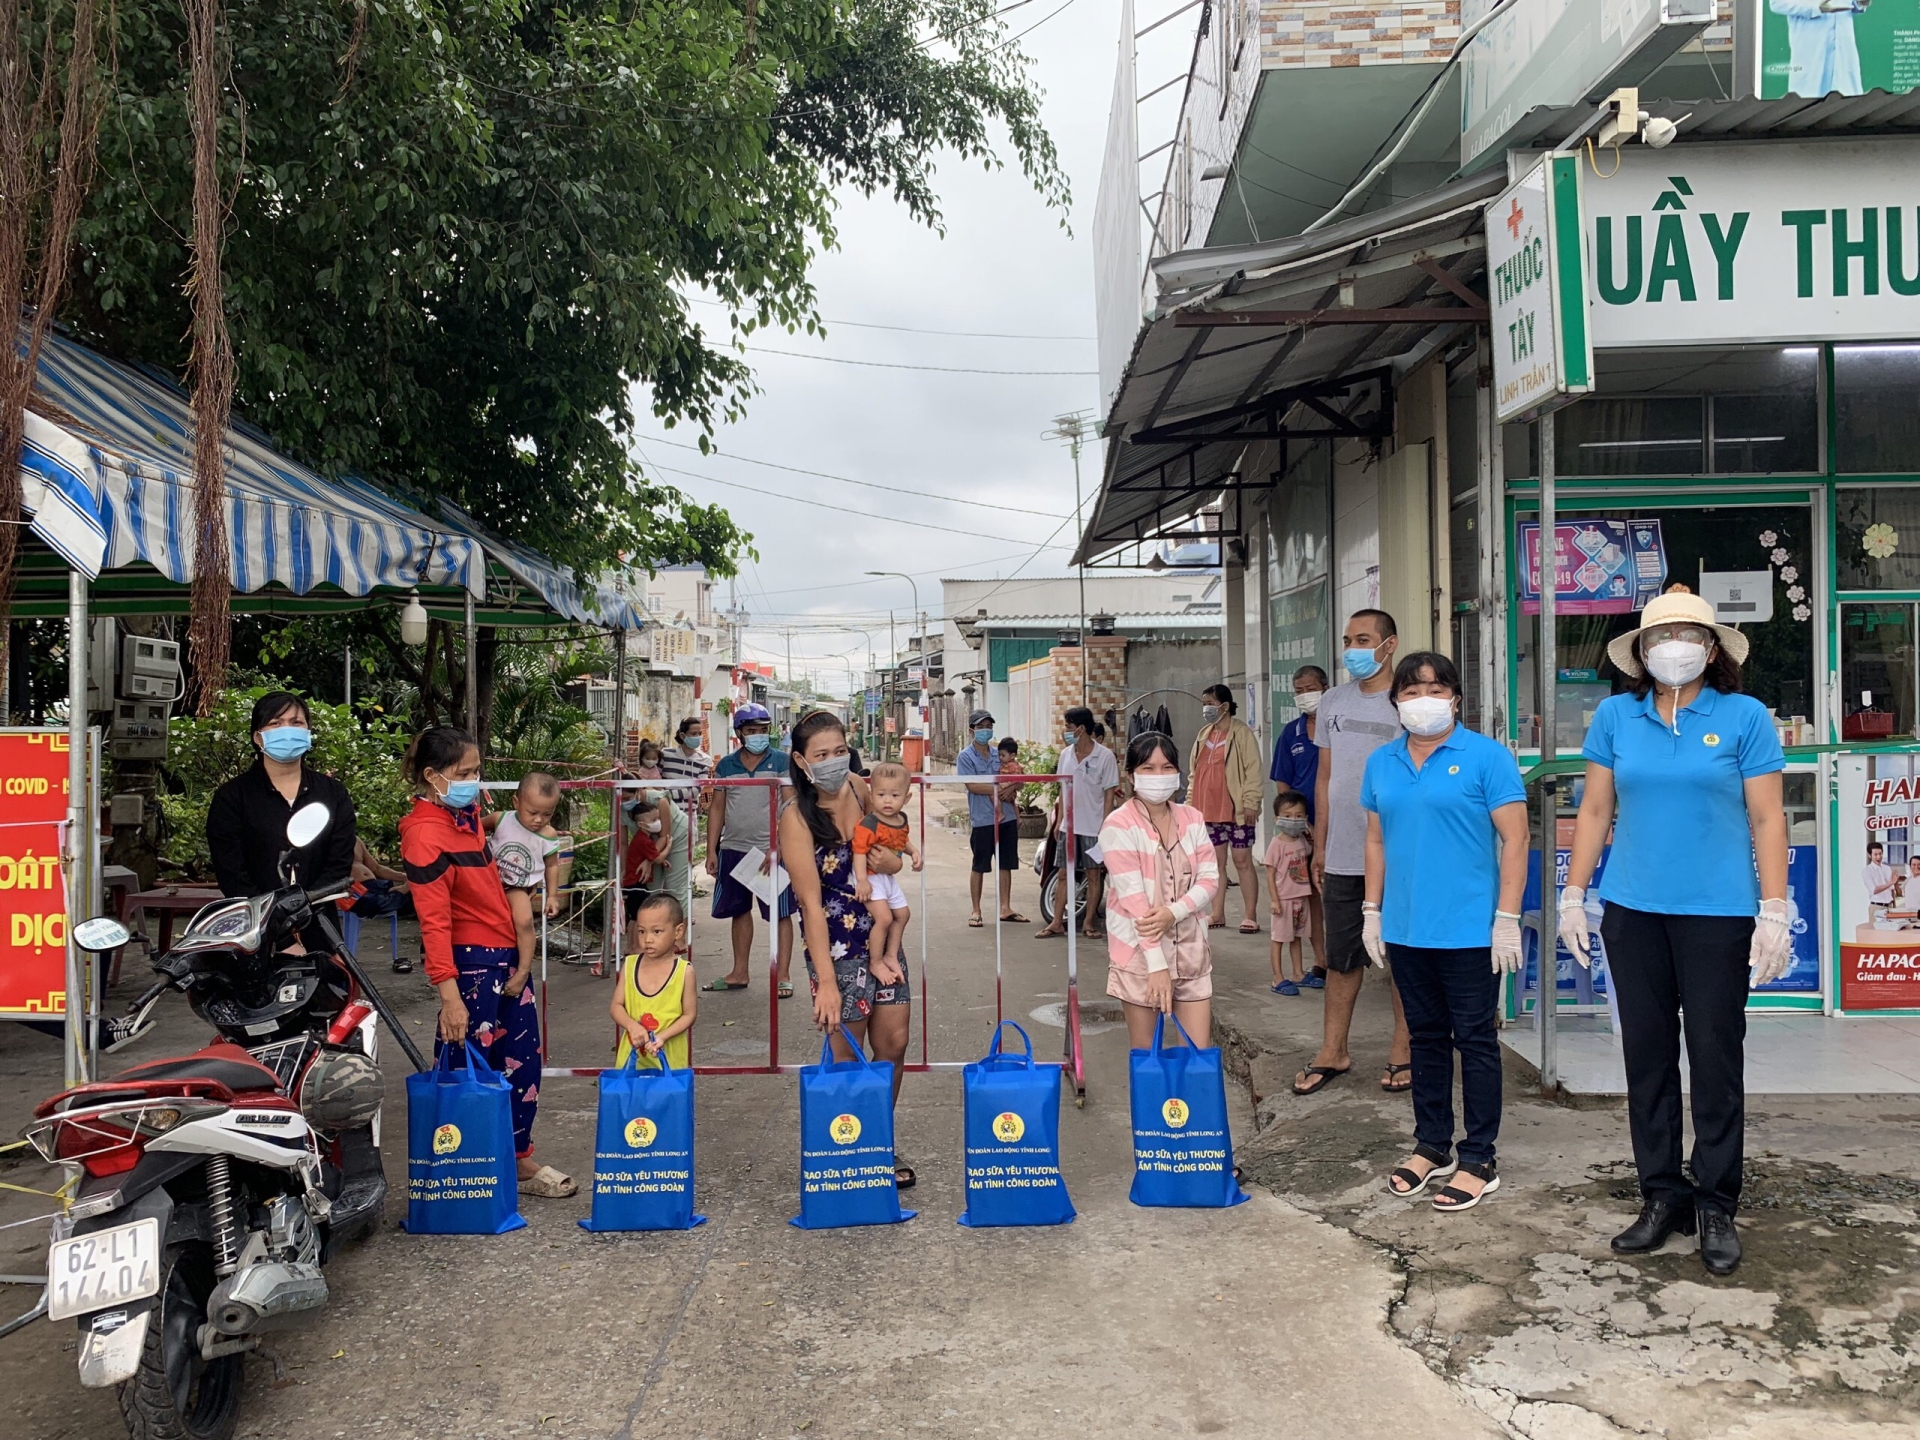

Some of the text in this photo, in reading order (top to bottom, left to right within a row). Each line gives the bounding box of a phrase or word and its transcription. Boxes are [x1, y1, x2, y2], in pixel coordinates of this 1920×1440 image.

[1770, 65, 1803, 73] Chuyên gia
[1589, 176, 1750, 305] UẦY
[1495, 225, 1543, 308] THUỐC
[1509, 308, 1535, 365] TÂY
[6, 778, 48, 795] COVID
[1866, 814, 1909, 831] Giảm
[11, 913, 66, 955] DỊC
[1856, 972, 1883, 981] Giảm
[1886, 972, 1906, 981] đau
[1156, 1149, 1171, 1159] SỮA
[1173, 1151, 1187, 1160] YÊU
[1189, 1150, 1226, 1158] THƯƠNG
[804, 1166, 894, 1179] RAO SỮA YÊU THƯƠNG
[968, 1167, 984, 1176] RAO
[987, 1166, 1004, 1175] SỮA
[1006, 1165, 1021, 1175] YÊU
[1138, 1160, 1222, 1173] ẤM TÌNH CÔNG ĐOÀN
[442, 1176, 457, 1186] YÊU
[459, 1176, 497, 1186] THƯƠNG
[616, 1172, 632, 1181] SỮA
[635, 1170, 650, 1180] YÊU
[653, 1170, 689, 1179] THƯƠNG
[597, 1182, 684, 1194] ẤM TÌNH CÔNG ĐOÀN
[805, 1177, 891, 1192] ẤM TÌNH CÔNG ĐOÀN
[969, 1177, 1056, 1189] ẤM TÌNH CÔNG ĐOÀN
[442, 1189, 466, 1199] CÔNG
[468, 1188, 492, 1198] ĐOÀN
